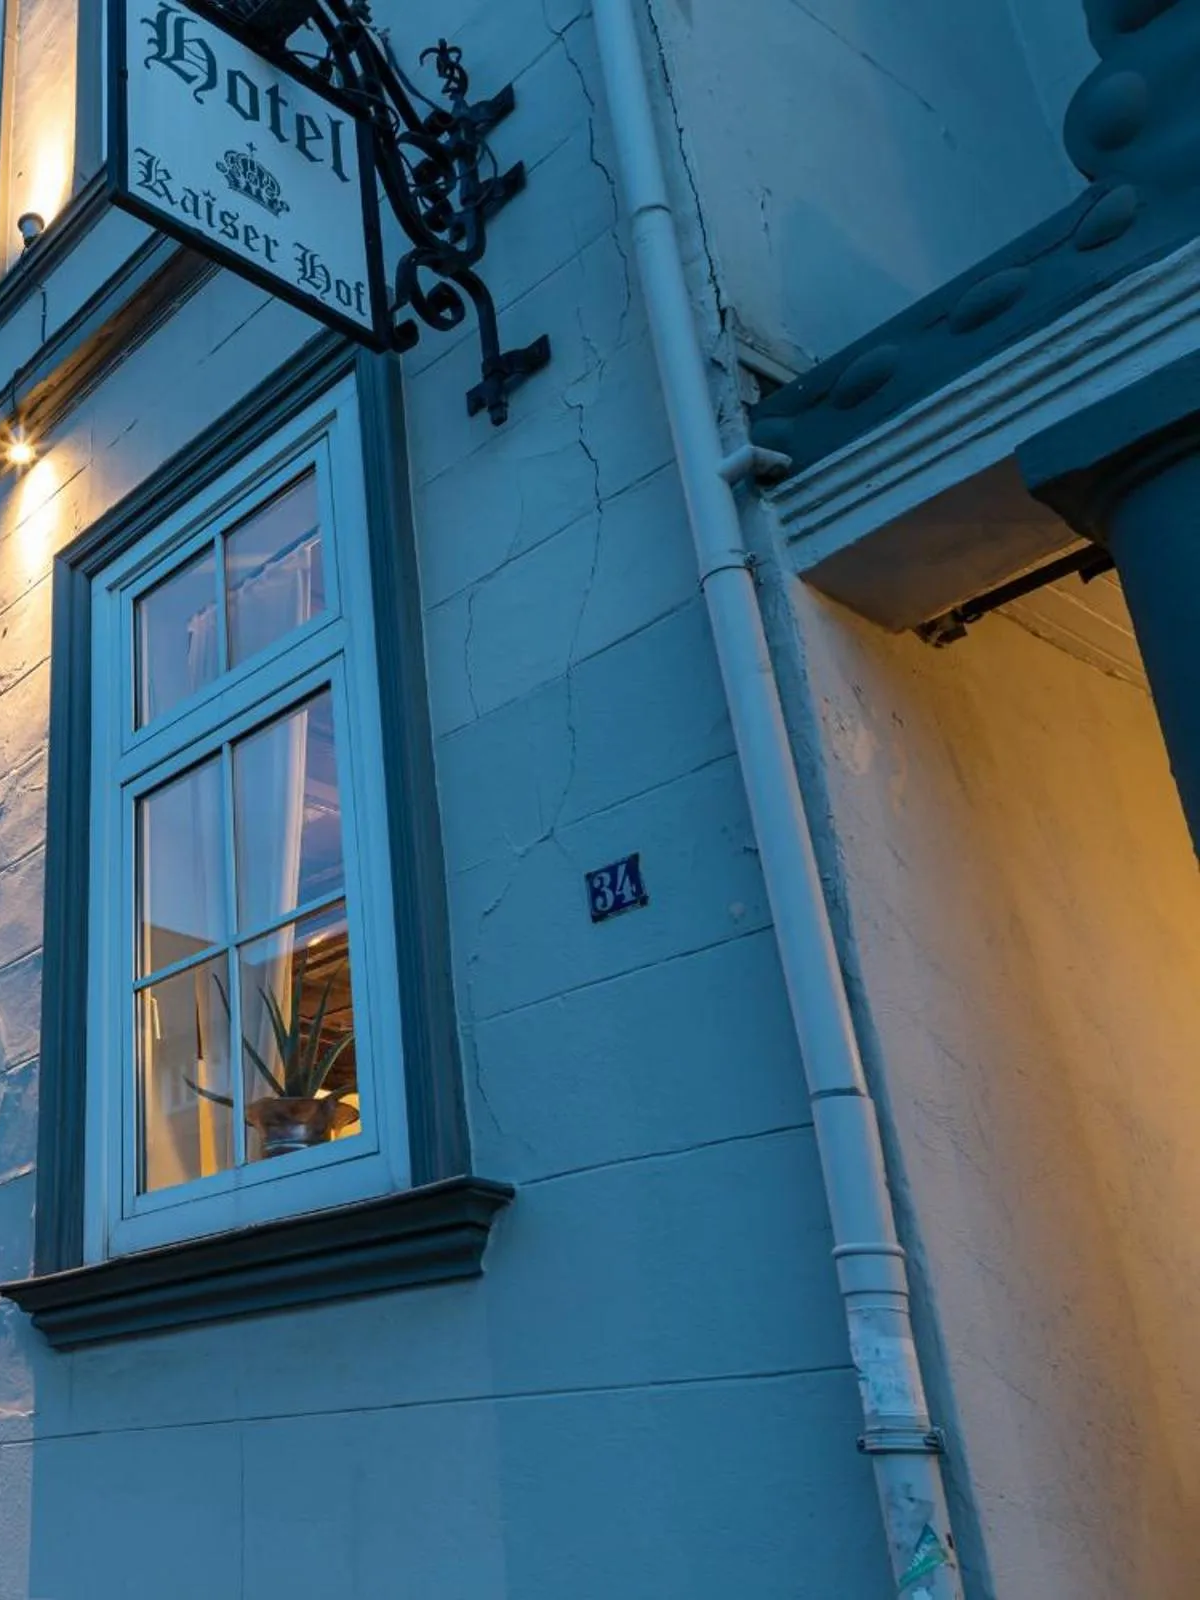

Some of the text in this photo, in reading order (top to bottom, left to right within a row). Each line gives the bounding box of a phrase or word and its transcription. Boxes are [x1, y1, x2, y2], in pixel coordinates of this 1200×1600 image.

[140, 1, 351, 184] Hotel
[134, 147, 370, 318] Kaiser Hof
[593, 863, 637, 912] 34
